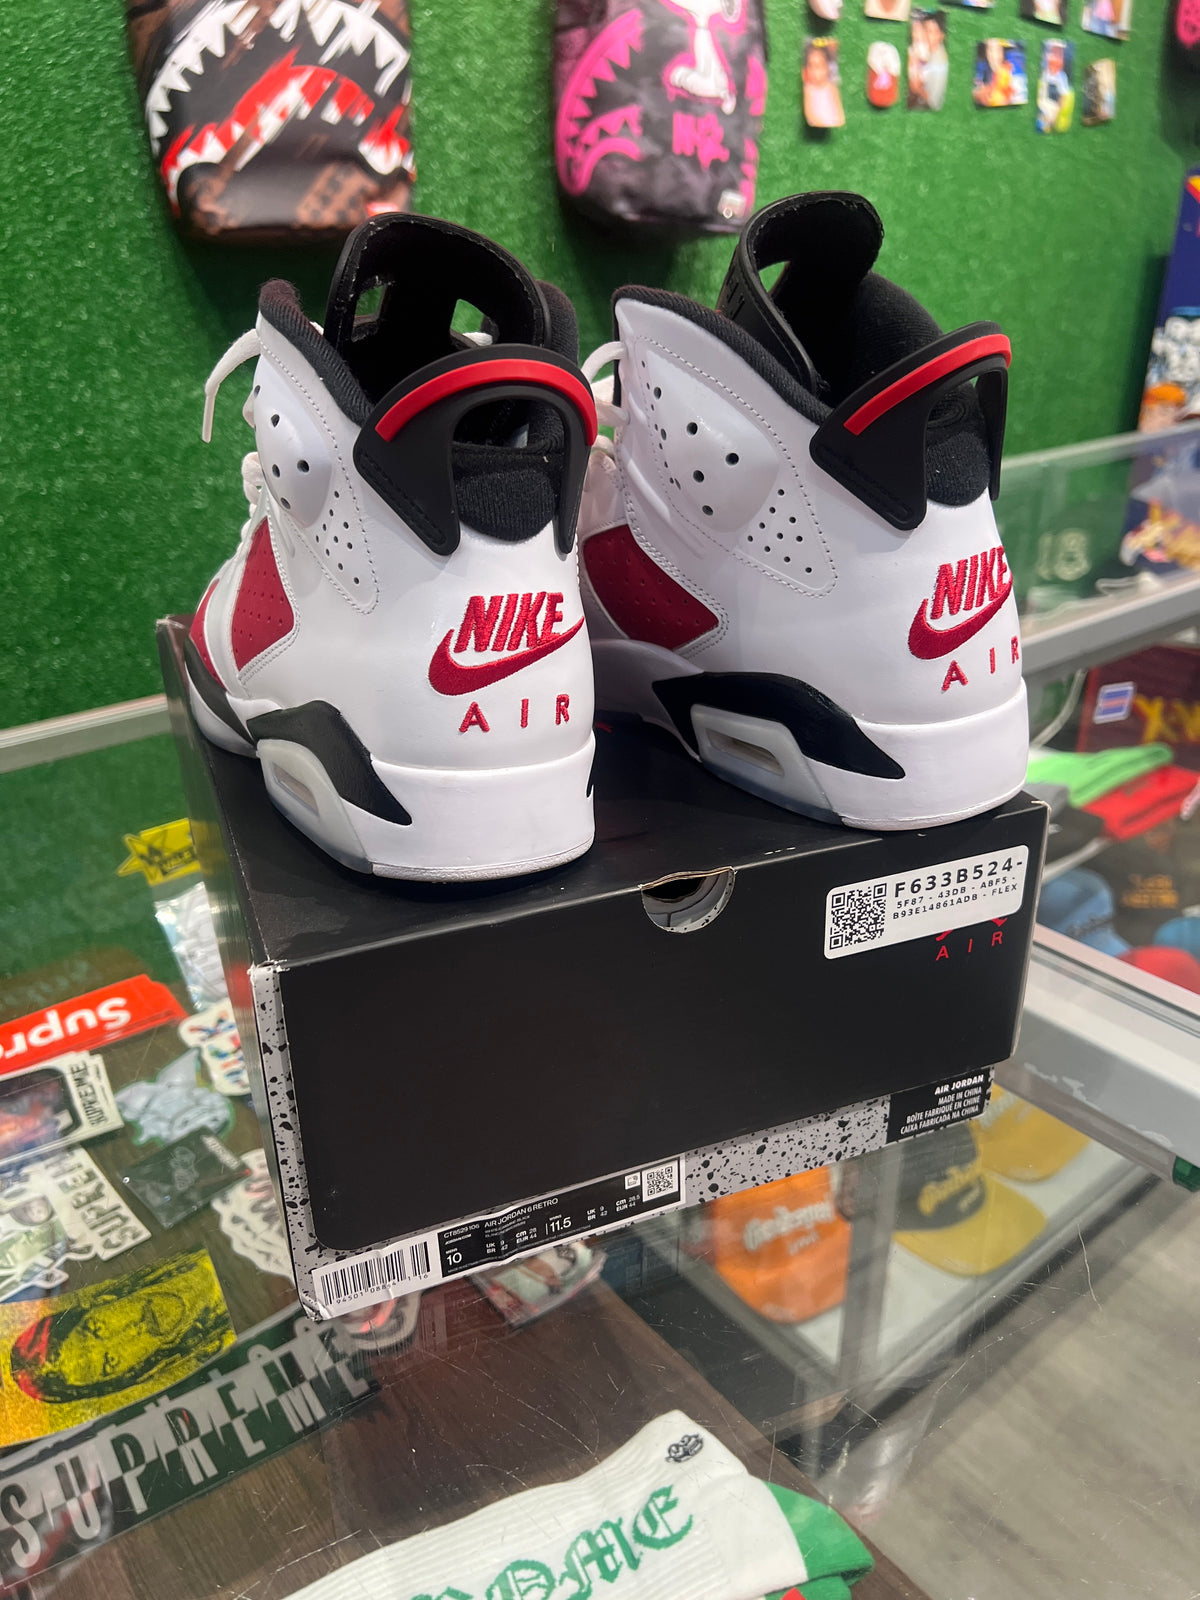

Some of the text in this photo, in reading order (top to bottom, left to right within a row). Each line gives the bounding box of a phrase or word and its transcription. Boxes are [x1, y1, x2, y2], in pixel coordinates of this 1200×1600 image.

[930, 545, 1008, 620] NIKE
[453, 591, 564, 653] NIKE
[941, 636, 1019, 692] AIR
[458, 694, 570, 733] AIR
[894, 857, 1023, 898] F633B524-
[991, 883, 1018, 896] FLEX
[896, 896, 924, 909] 5F87
[935, 931, 1003, 961] AIR
[0, 997, 132, 1059] Supr
[934, 1074, 984, 1096] AIR JORDAN
[937, 1086, 982, 1106] MADE IN CHINA
[953, 1100, 962, 1110] EN
[962, 1095, 981, 1108] CHINE
[900, 1104, 979, 1135] CAIXA FABRICADA NA CHINA
[484, 1220, 497, 1228] AIR
[497, 1208, 527, 1225] JORDAN
[532, 1197, 559, 1211] RETRO
[587, 1208, 596, 1216] UK
[615, 1198, 627, 1206] cm
[515, 1230, 527, 1238] cm
[549, 1216, 572, 1233] 11.5
[446, 1252, 463, 1266] 10
